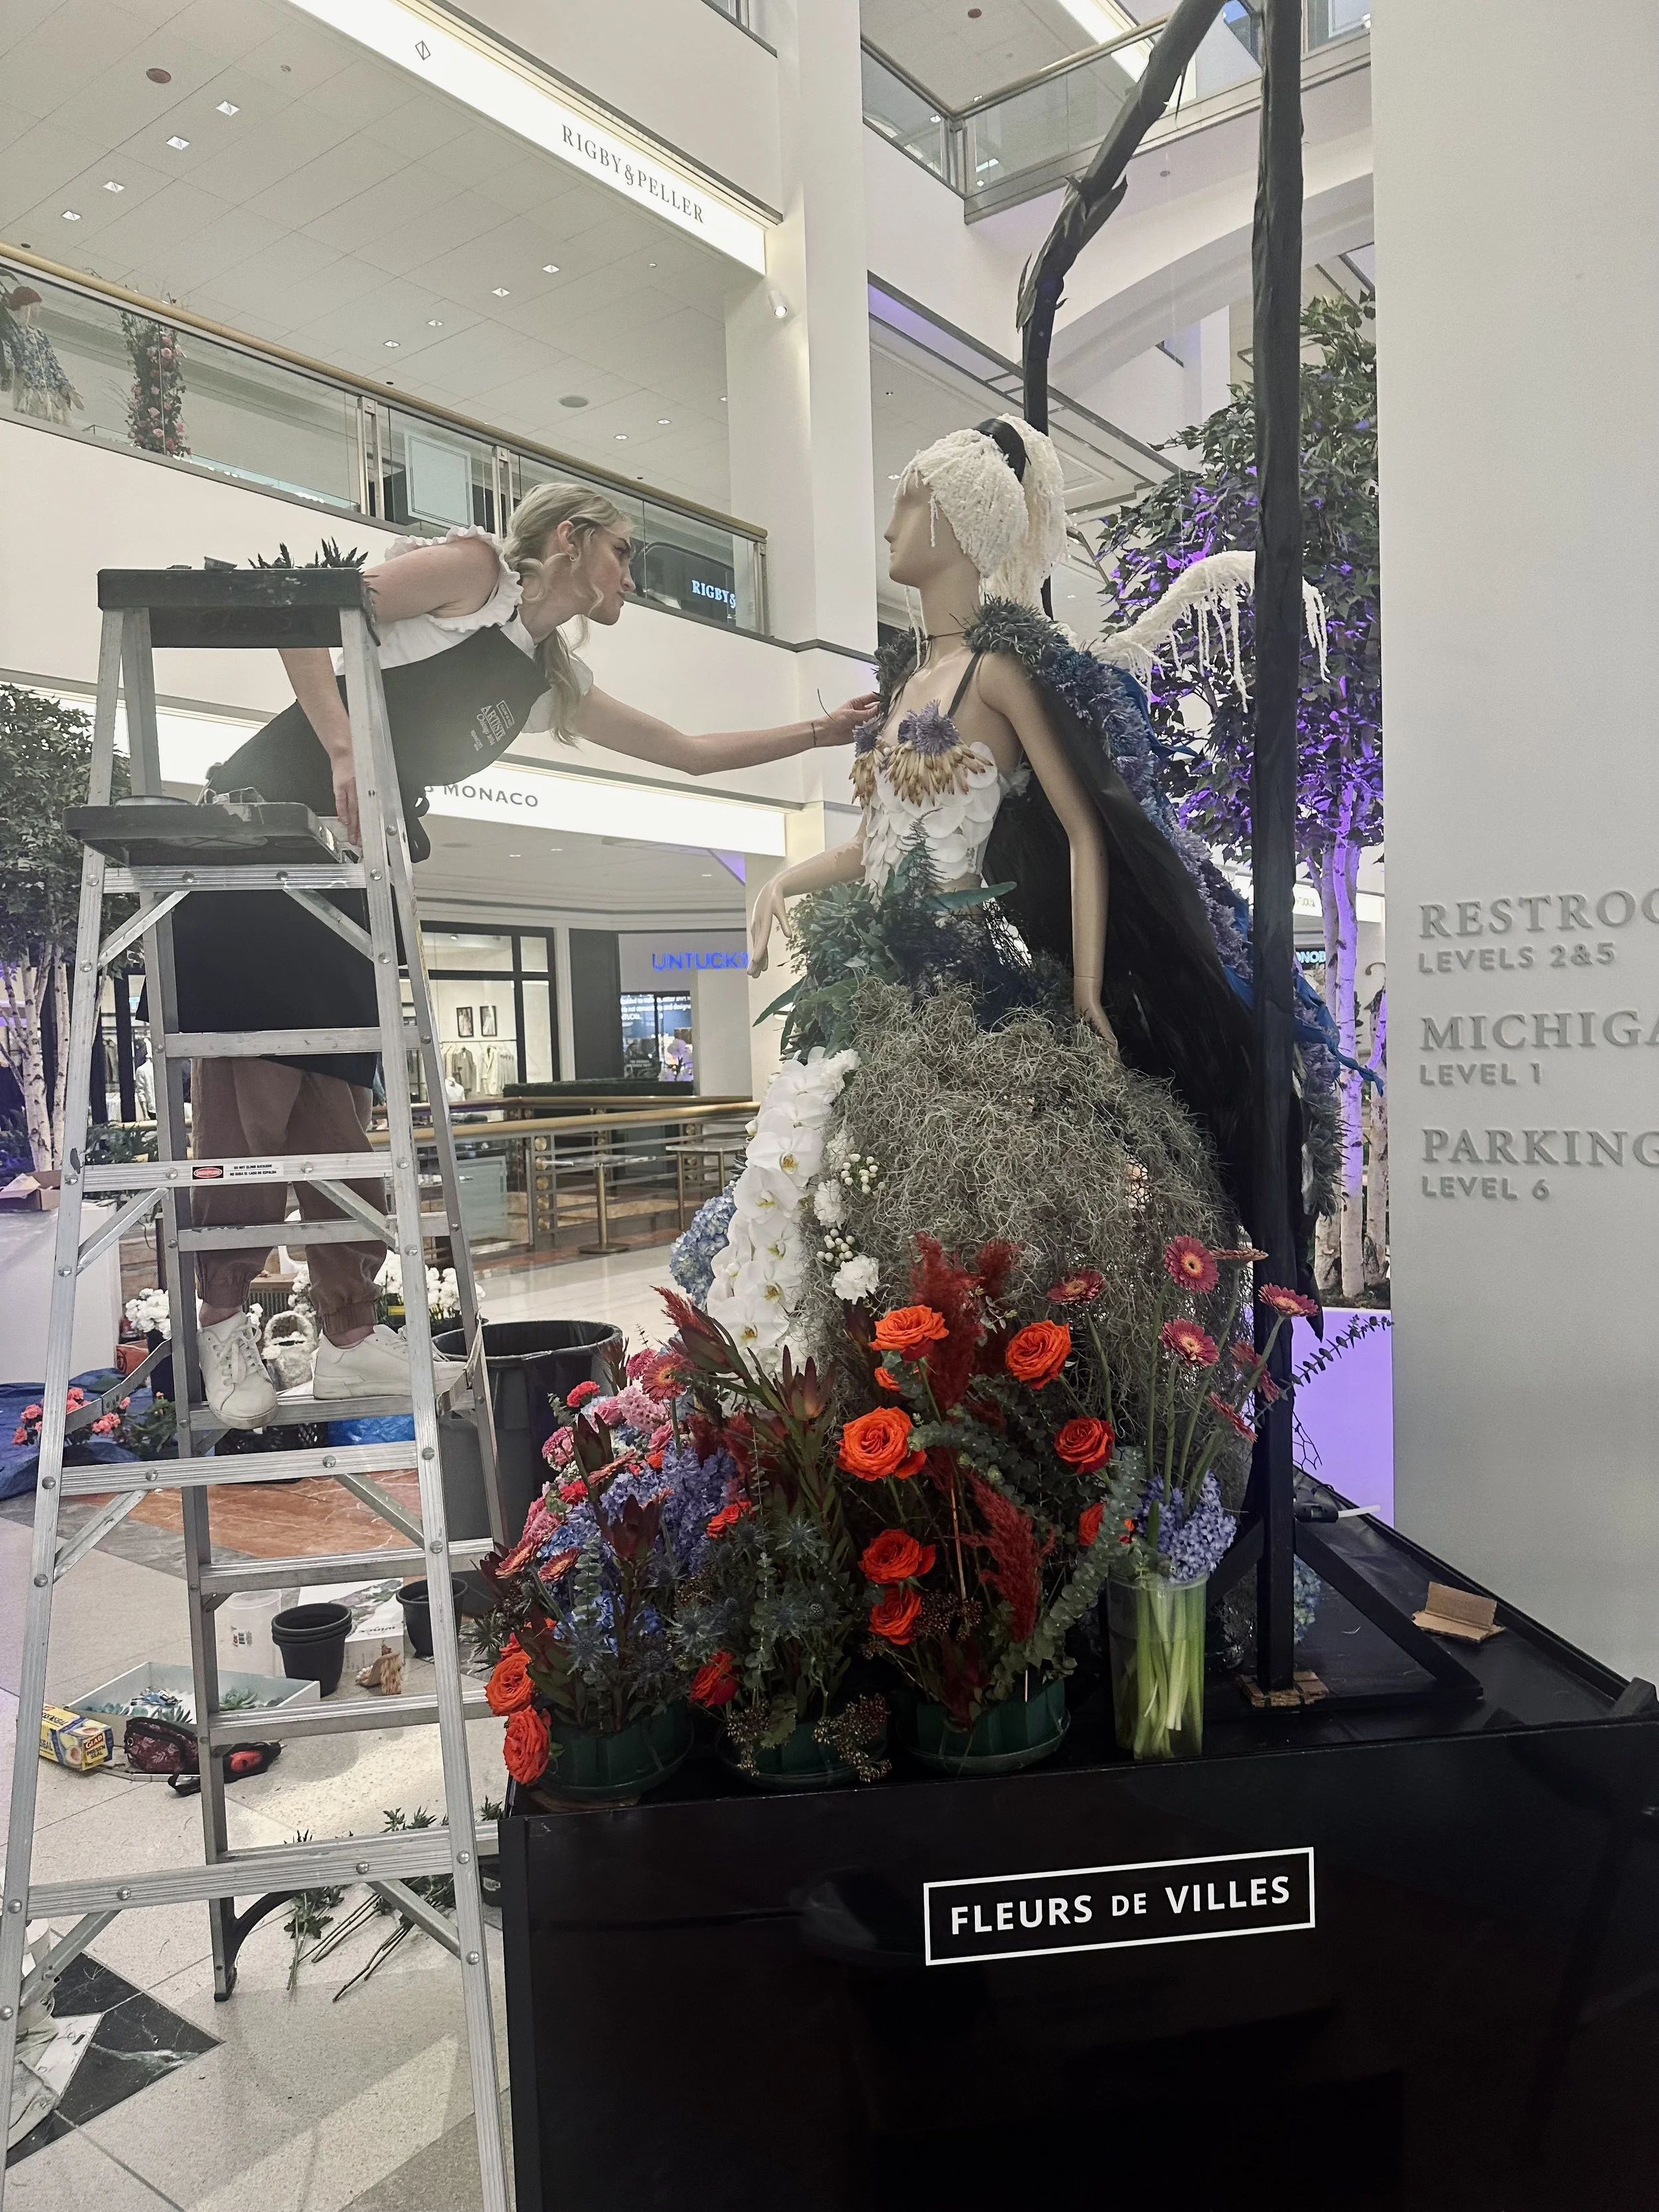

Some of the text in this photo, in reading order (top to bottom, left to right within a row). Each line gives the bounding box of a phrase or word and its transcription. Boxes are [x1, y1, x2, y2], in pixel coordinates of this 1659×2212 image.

[480, 705, 506, 741] ARTISTE
[444, 784, 539, 807] MONACO
[1419, 941, 1615, 973] LEVELS 2&5
[1420, 1063, 1542, 1086] LEVEL 1
[1422, 1128, 1659, 1167] PARKING
[1421, 1175, 1550, 1201] LEVEL 6
[85, 1734, 103, 1749] GLAD
[951, 1876, 1289, 1935] FLEURS DE VILLES
